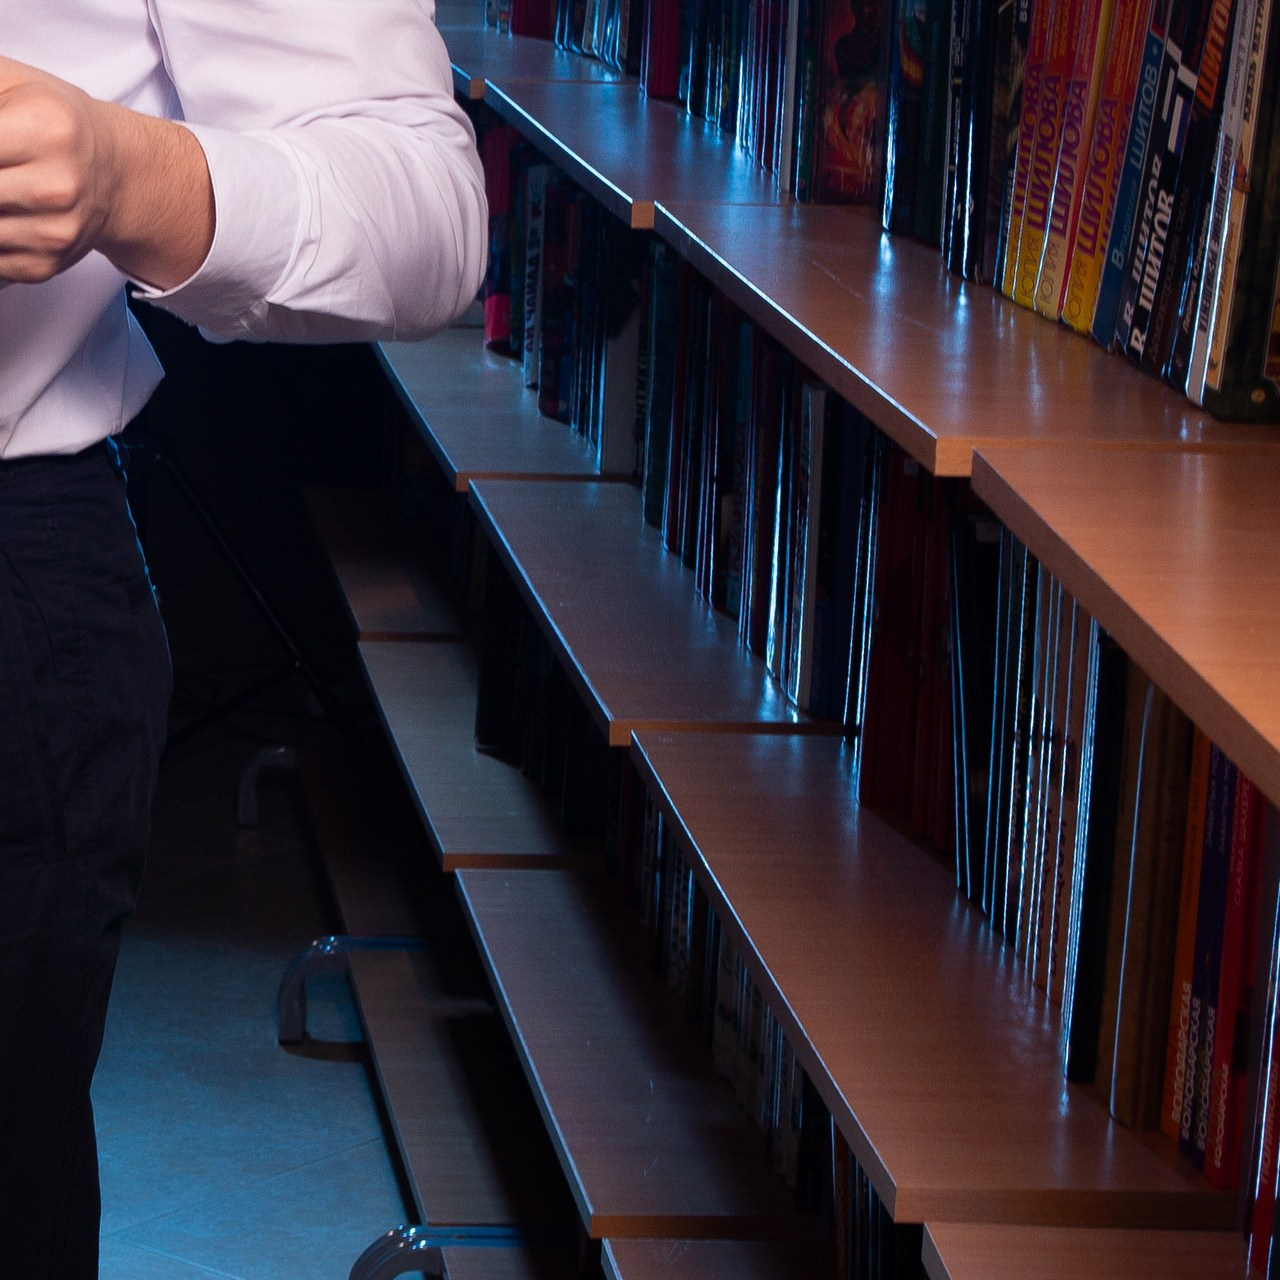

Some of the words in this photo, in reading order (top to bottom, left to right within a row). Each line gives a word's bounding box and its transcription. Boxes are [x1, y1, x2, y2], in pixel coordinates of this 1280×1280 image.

[1026, 73, 1061, 232] ШИЛОВА
[1049, 78, 1088, 239] ШИЛОВА
[1076, 97, 1118, 258] ШИЛОВА
[1129, 63, 1158, 171] ШИТОВ
[1138, 187, 1175, 312] ШИТОВ
[1238, 778, 1251, 842] ШАХЕРЕ
[1171, 980, 1192, 1124] ВОЛОДАРСКАЯ
[1180, 995, 1202, 1141] ВОЛОДАРСКАЯ
[1197, 1005, 1216, 1151] ВОЛОДАРСКАЯ
